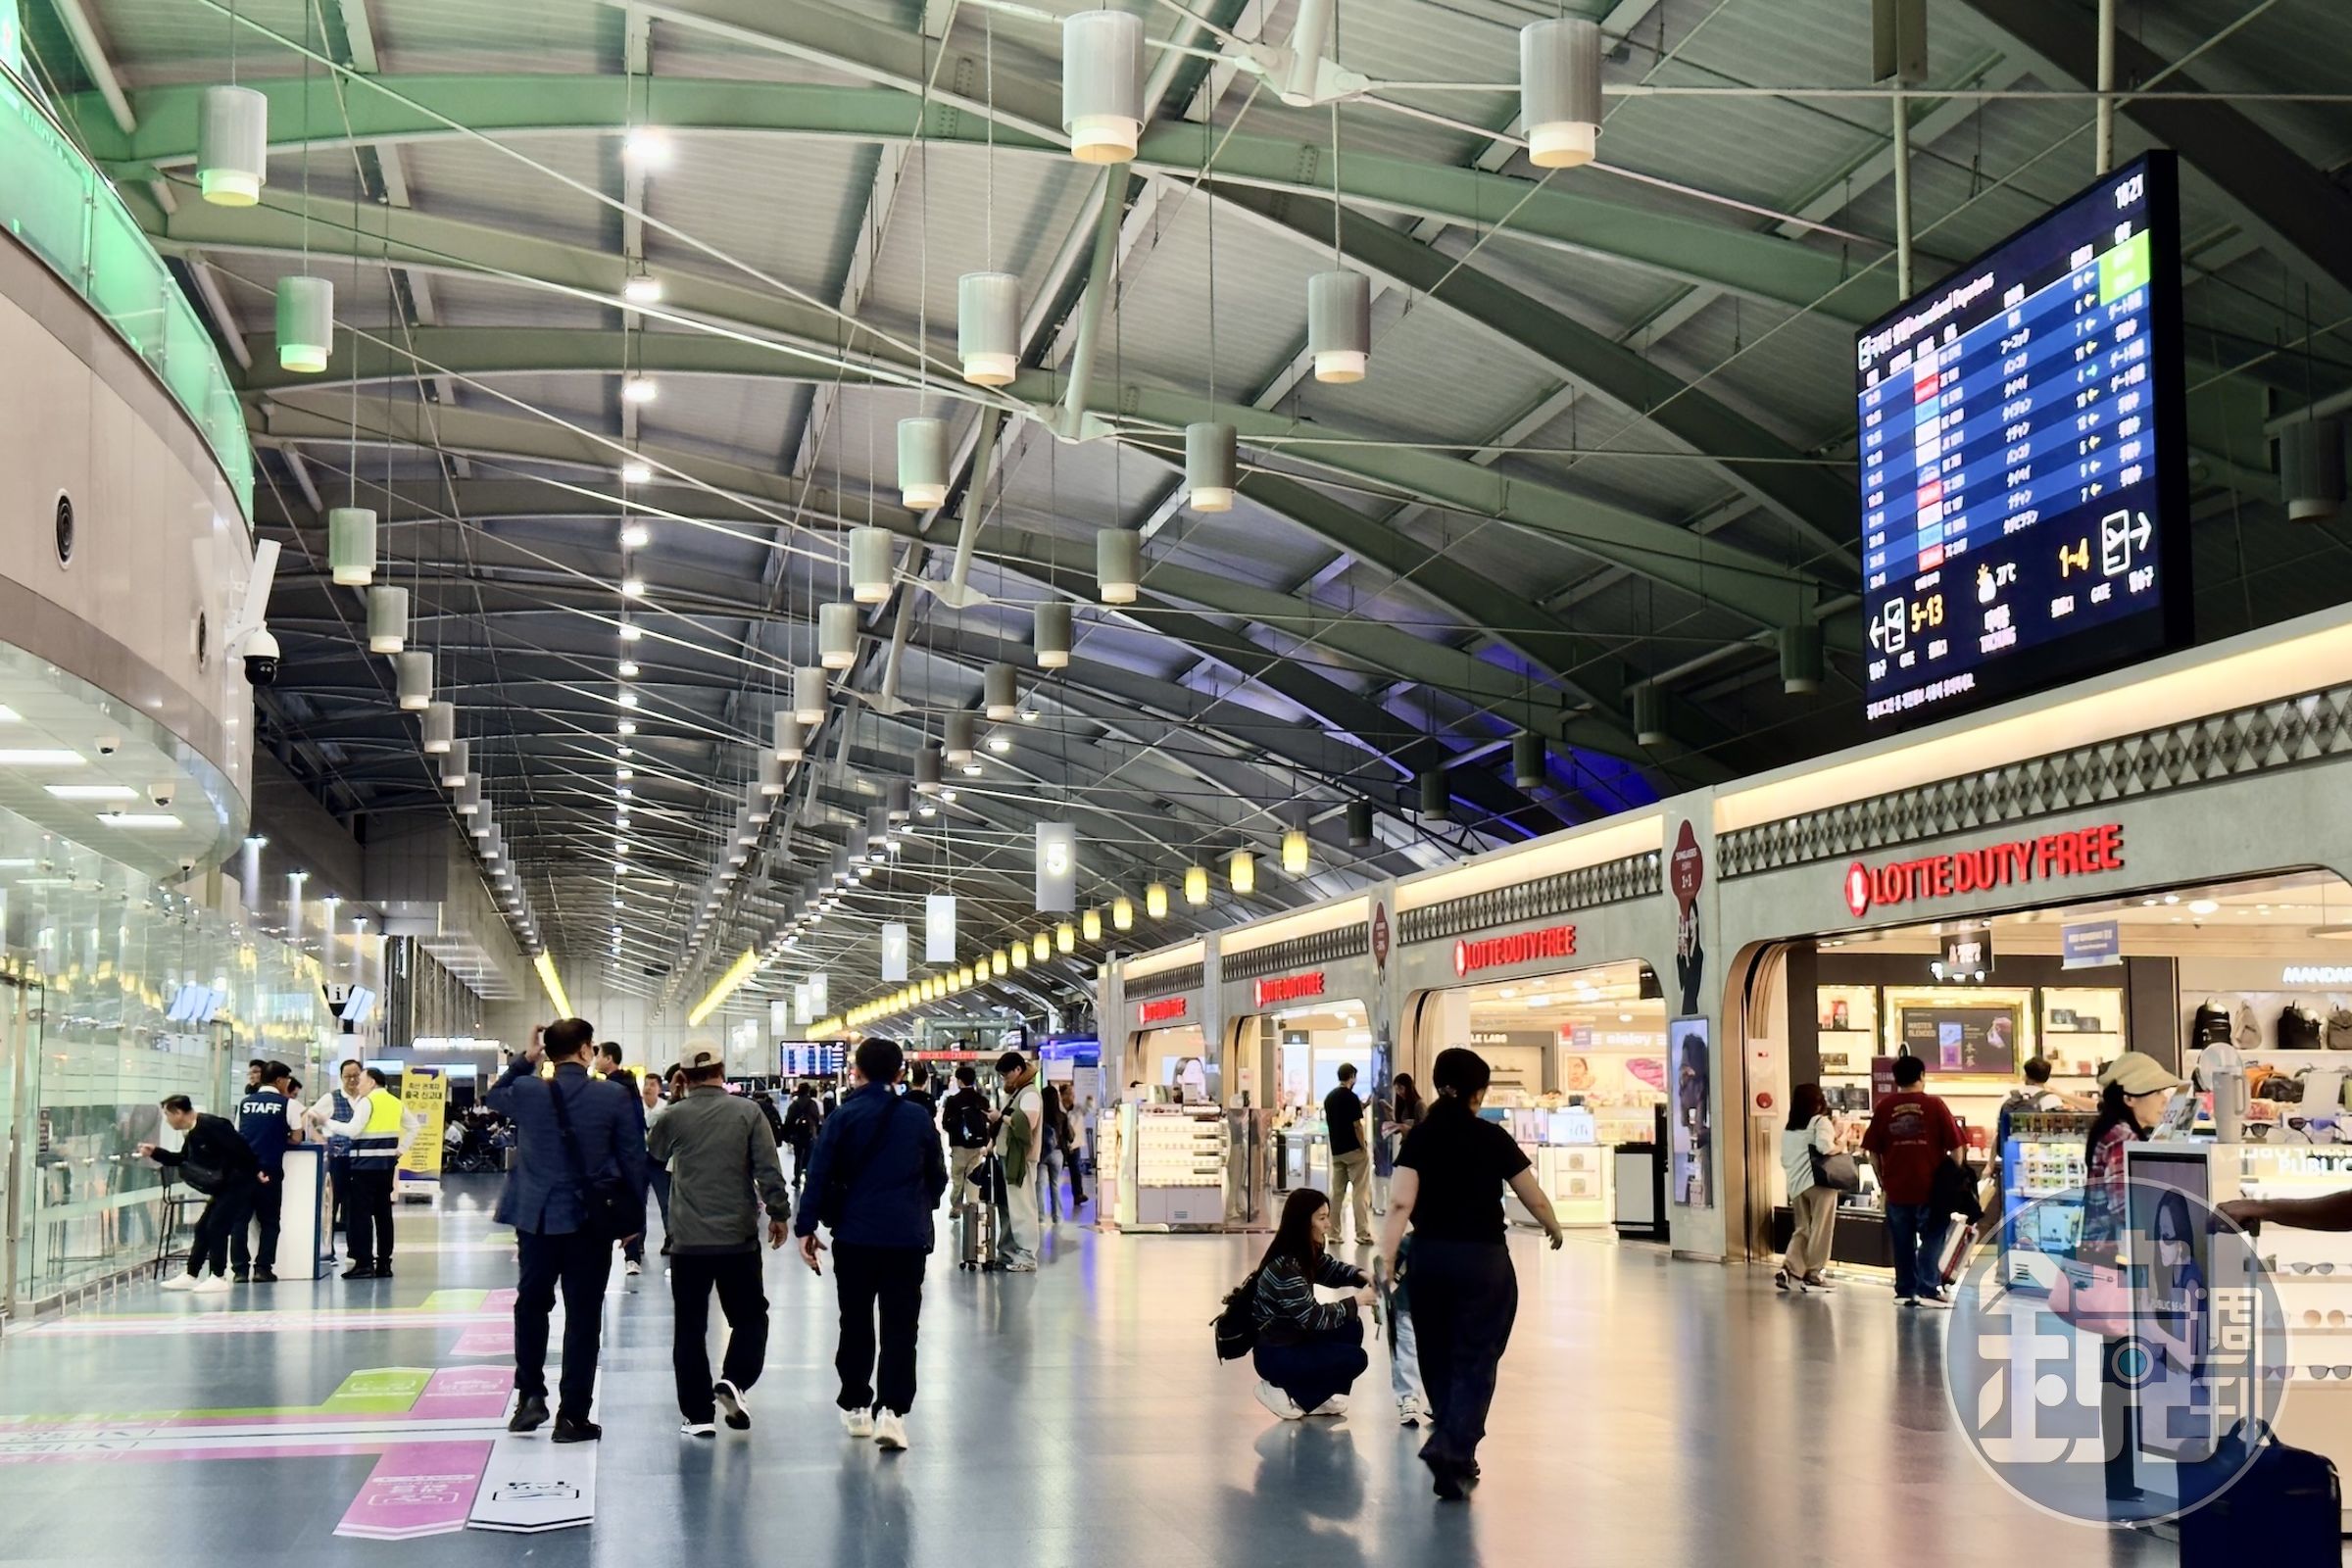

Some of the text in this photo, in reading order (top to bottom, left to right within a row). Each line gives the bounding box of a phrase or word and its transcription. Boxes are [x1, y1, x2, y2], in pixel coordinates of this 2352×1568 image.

[1046, 842, 1067, 876] 5
[1869, 824, 2125, 906] LOTTE DUTY FREE
[1465, 925, 1577, 970] LOTTE DUTY FREE
[242, 1102, 282, 1114] STAFF
